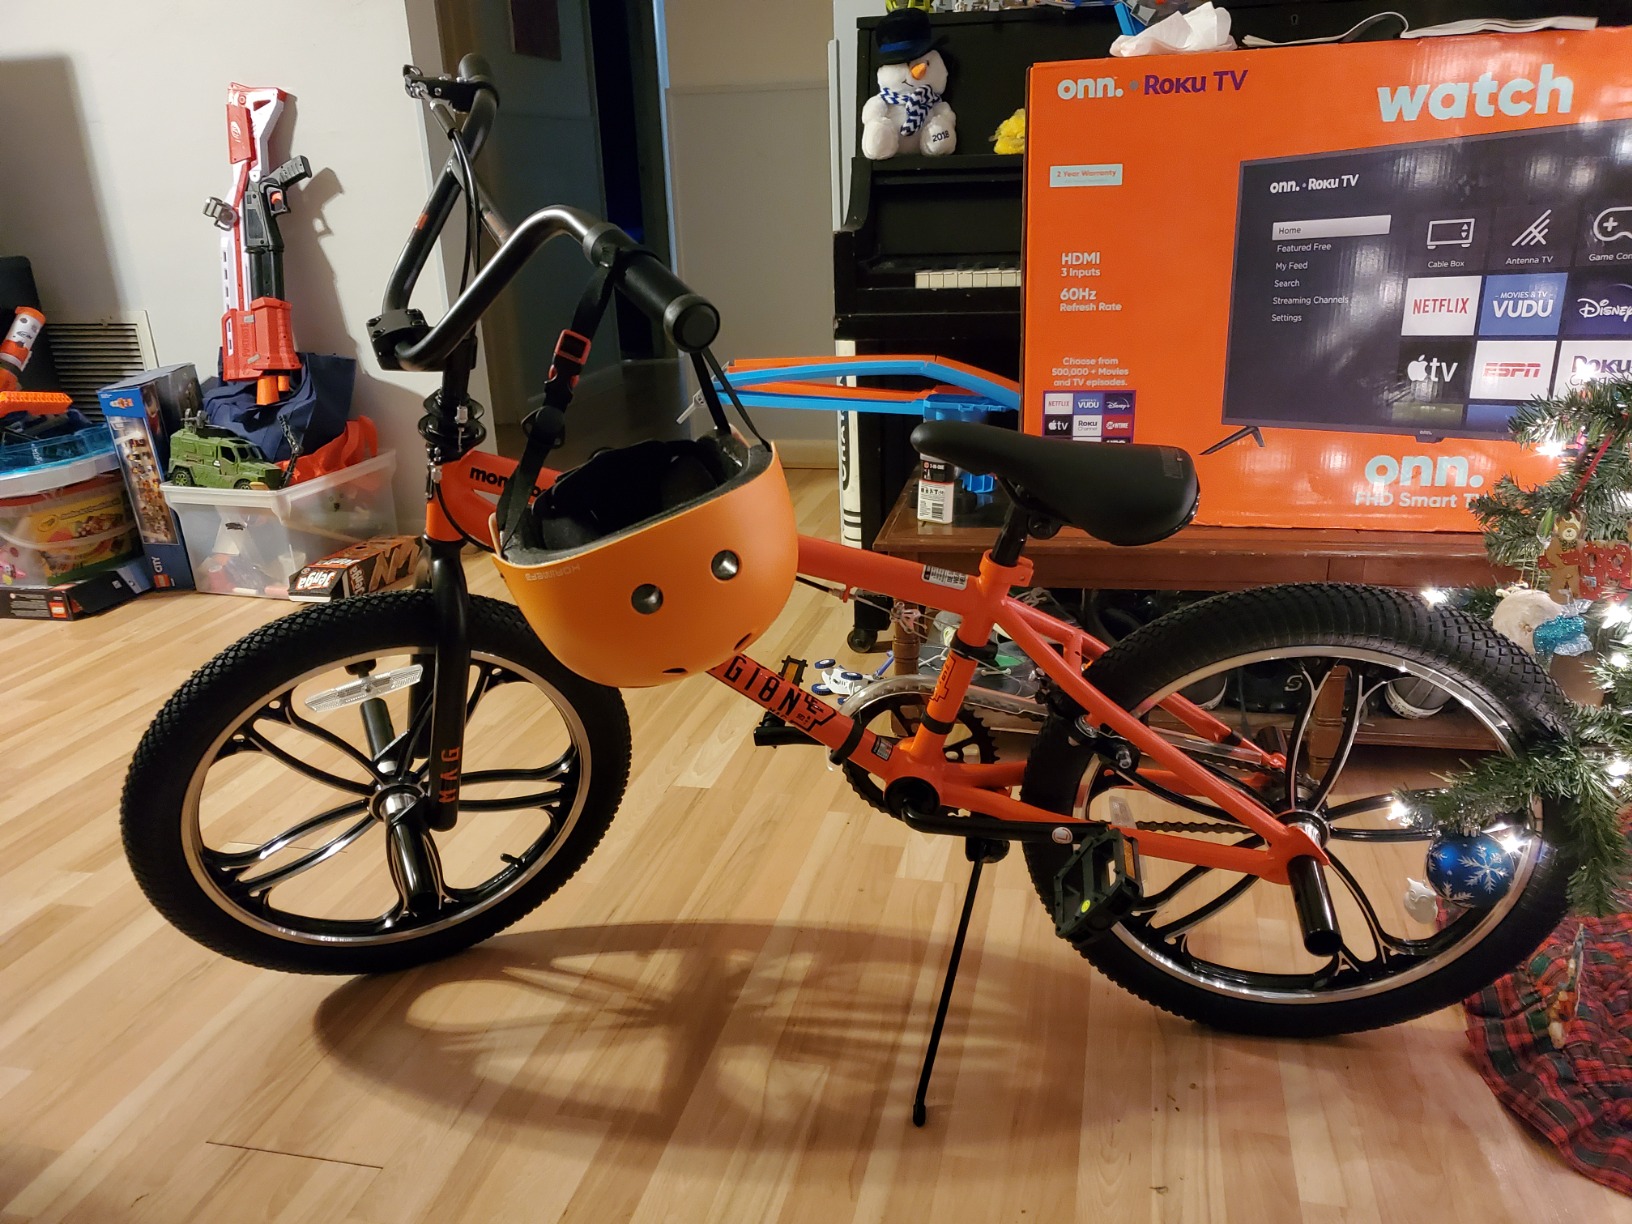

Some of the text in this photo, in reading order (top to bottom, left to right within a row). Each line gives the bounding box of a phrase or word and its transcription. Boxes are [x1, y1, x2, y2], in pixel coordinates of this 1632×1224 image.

[1057, 69, 1249, 100] onn. Roku TV
[1376, 63, 1575, 122] watch
[932, 130, 950, 143] 2018
[1081, 169, 1117, 177] Warranty
[1270, 173, 1360, 194] onn. Roku TV
[1278, 226, 1302, 235] Home
[1277, 242, 1332, 253] Featured Free
[1061, 252, 1100, 265] HDMI
[1427, 259, 1465, 268] Cable Box
[1505, 255, 1554, 265] Antenna TV
[1588, 253, 1614, 262] Game
[1275, 261, 1308, 271] My Feed
[1060, 267, 1101, 278] 3 Inputs
[1274, 279, 1300, 288] Search
[1060, 288, 1097, 301] 60Hz
[1272, 294, 1349, 306] Streaming Channels
[1500, 291, 1528, 299] MOVIES
[1537, 290, 1548, 298] TV
[1059, 302, 1122, 312] Refresh Rate
[1412, 297, 1470, 315] NETFLIX
[1492, 299, 1553, 318] VUDU
[1271, 313, 1302, 323] Settings
[1062, 357, 1119, 366] Choose from
[1052, 367, 1089, 378] 500,000
[1098, 367, 1129, 376] Movies
[1429, 357, 1459, 383] tv
[1483, 362, 1542, 378] ESPN
[1053, 378, 1128, 388] and TV episodes.
[1364, 454, 1485, 488] onn.
[1355, 493, 1394, 507] FHD
[1399, 492, 1457, 508] Smart
[152, 556, 164, 573] CITY
[297, 570, 336, 590] Jenga
[438, 746, 460, 804] MAG
